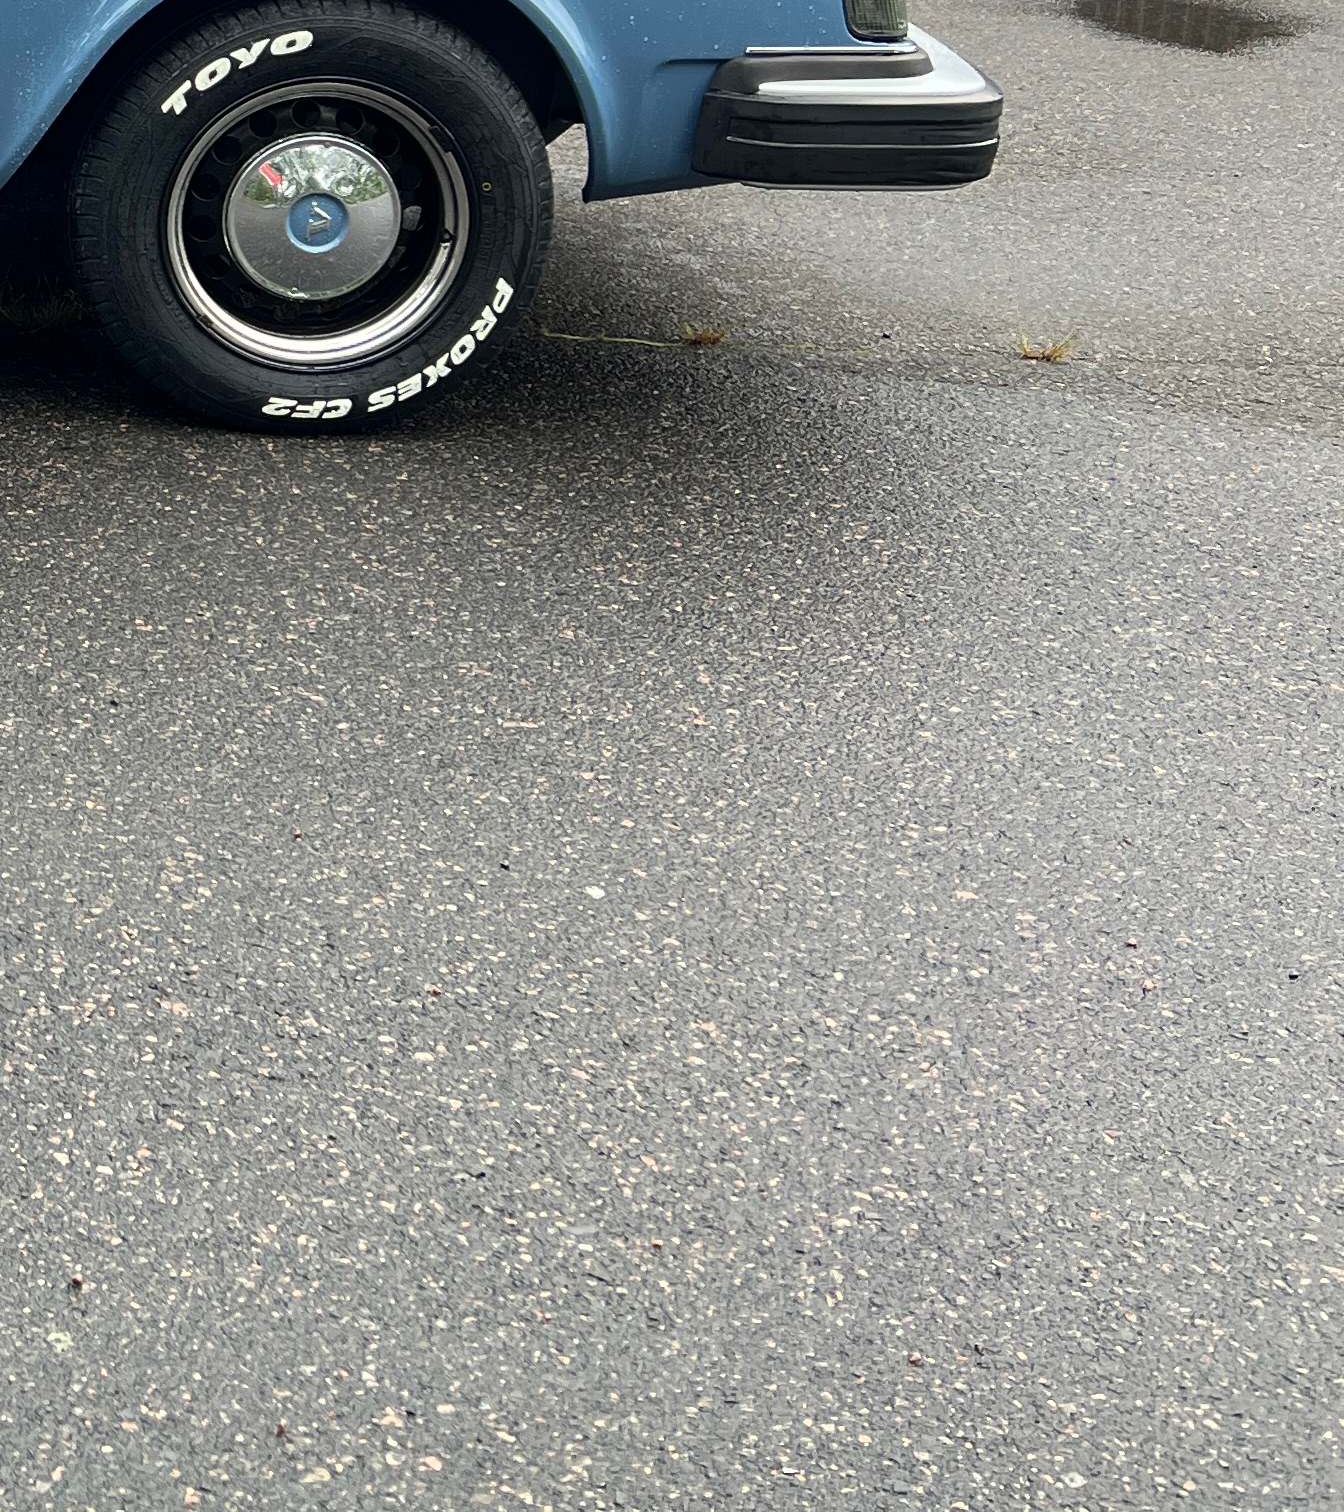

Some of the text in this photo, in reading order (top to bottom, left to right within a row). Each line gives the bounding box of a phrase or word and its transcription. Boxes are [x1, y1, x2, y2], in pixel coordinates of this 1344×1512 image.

[160, 30, 314, 116] TOYO
[261, 277, 514, 419] PROXES CF2
